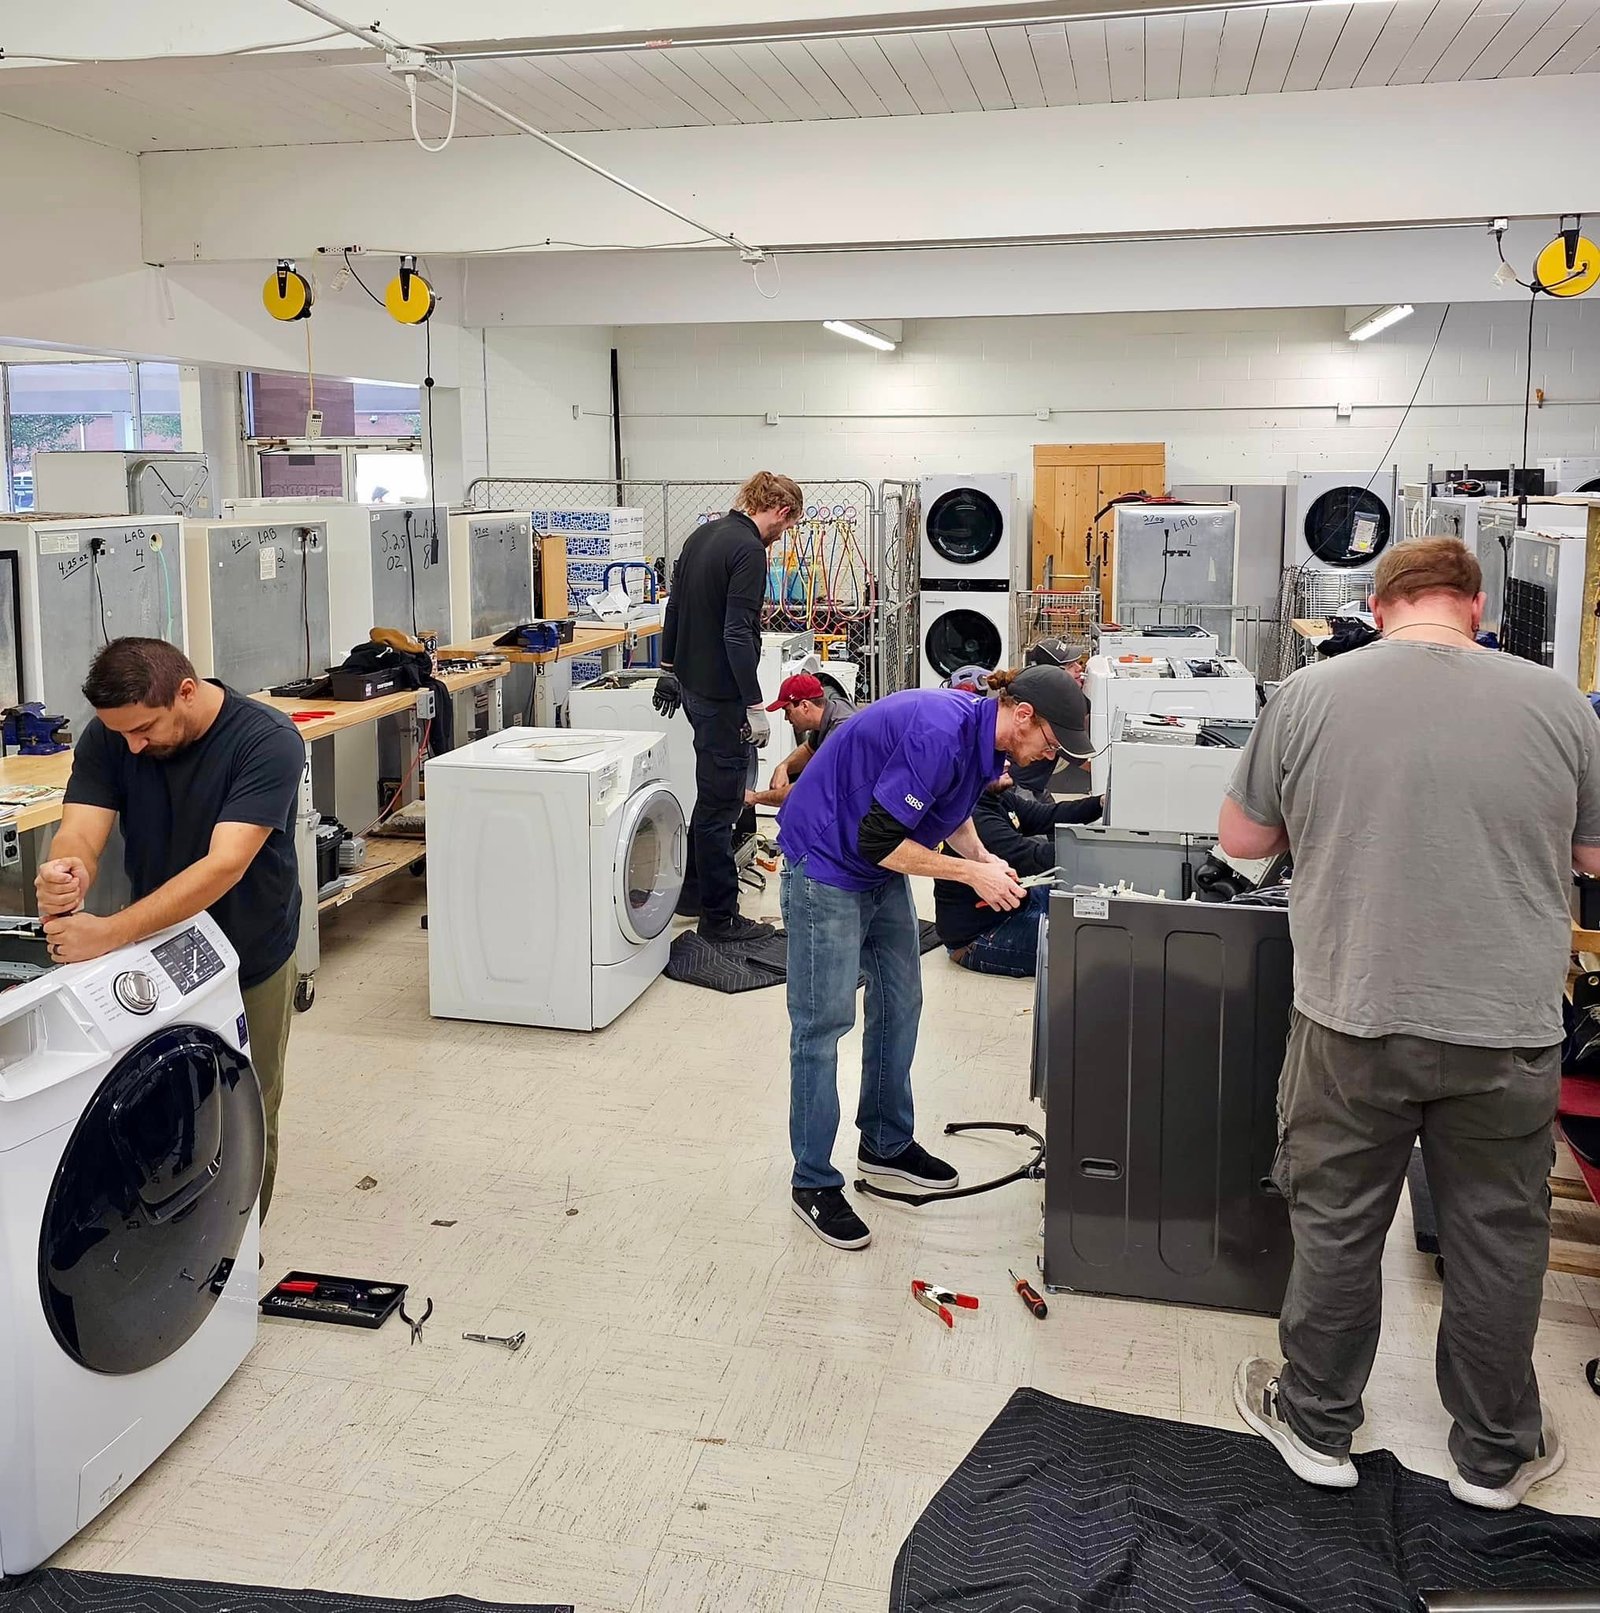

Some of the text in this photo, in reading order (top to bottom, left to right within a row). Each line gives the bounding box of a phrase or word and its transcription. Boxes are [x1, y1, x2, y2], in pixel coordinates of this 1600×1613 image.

[1173, 515, 1198, 532] LAB
[124, 529, 145, 543] LAB
[258, 528, 277, 544] LAB
[381, 530, 406, 553] 5.25
[136, 549, 144, 562] 4
[277, 548, 286, 563] 2
[424, 544, 432, 569] 8
[58, 557, 77, 575] 4.25
[537, 665, 544, 676] 3
[303, 762, 310, 784] 2
[905, 793, 925, 811] SBS
